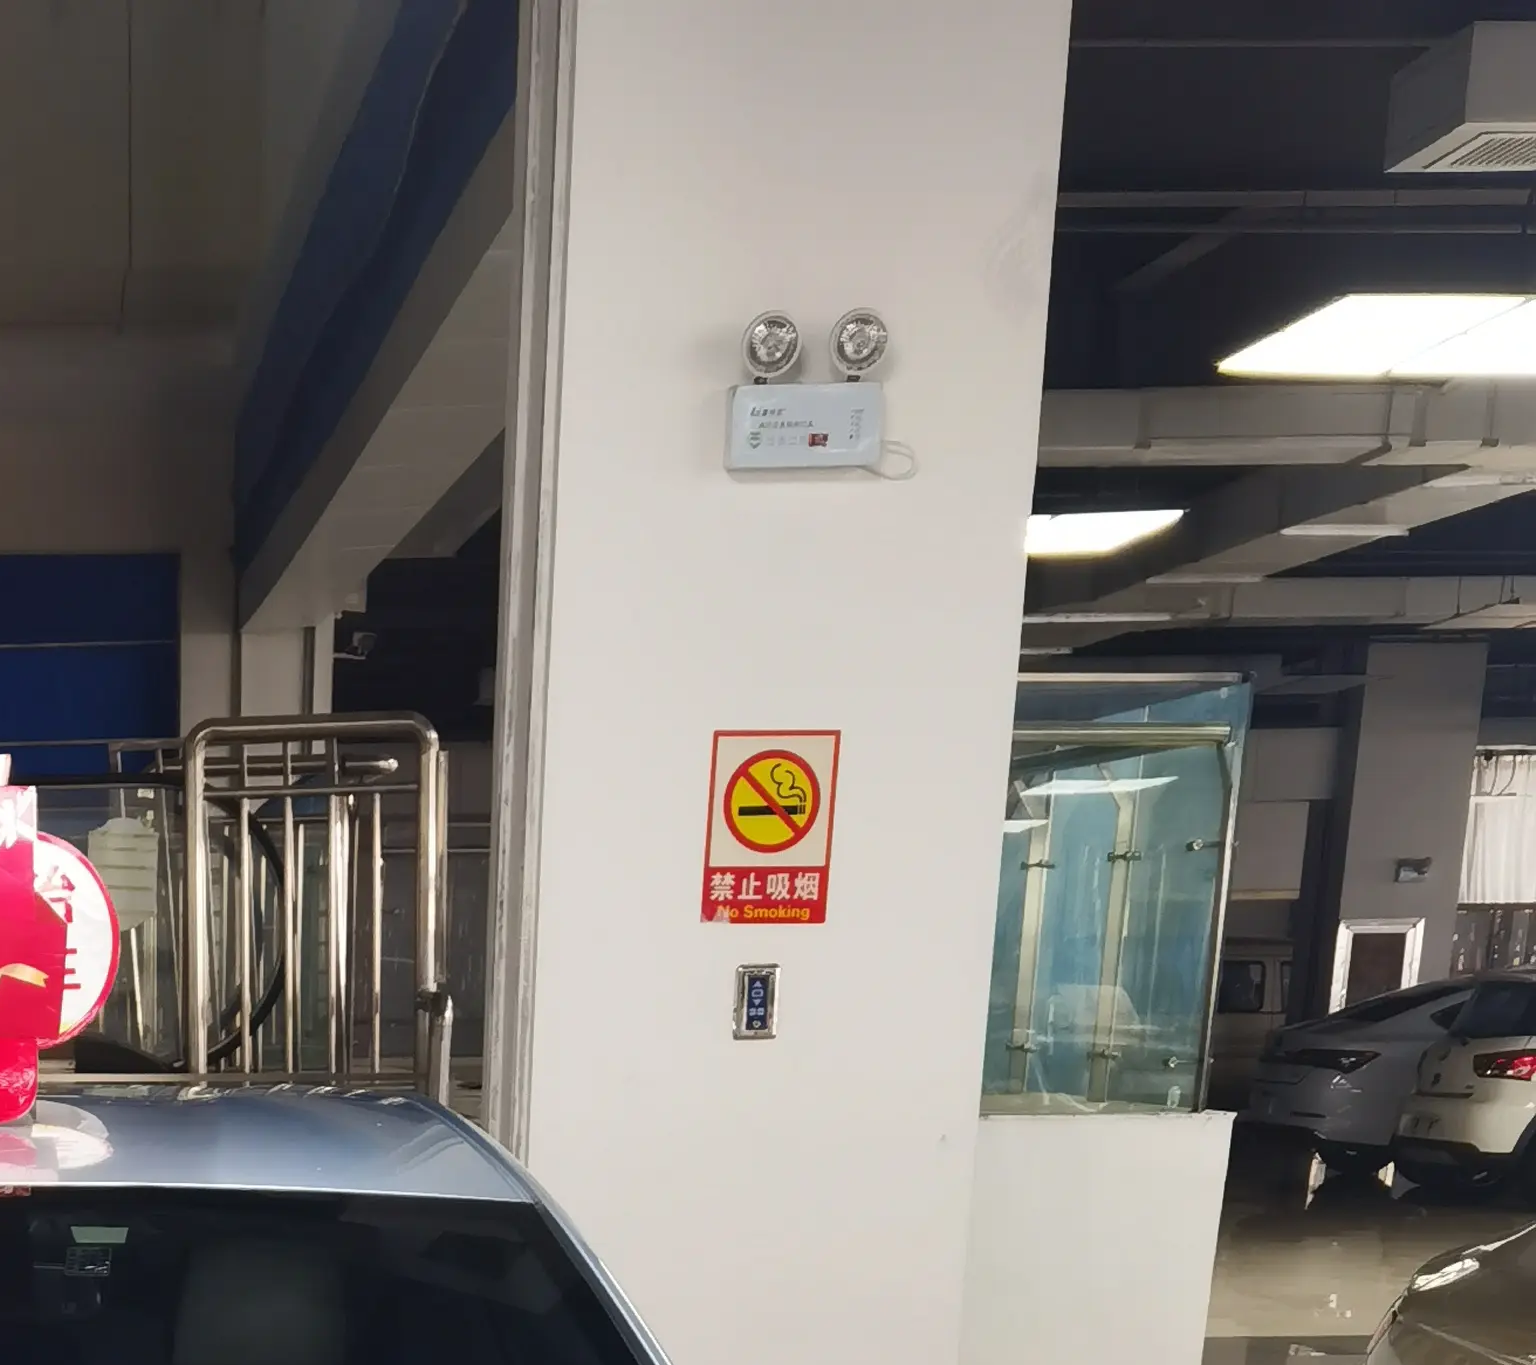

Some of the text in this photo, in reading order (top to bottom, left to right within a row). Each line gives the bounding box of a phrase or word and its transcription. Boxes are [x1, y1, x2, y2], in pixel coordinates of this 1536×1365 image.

[709, 872, 820, 901] 禁止吸烟
[716, 904, 811, 921] No Smoking
